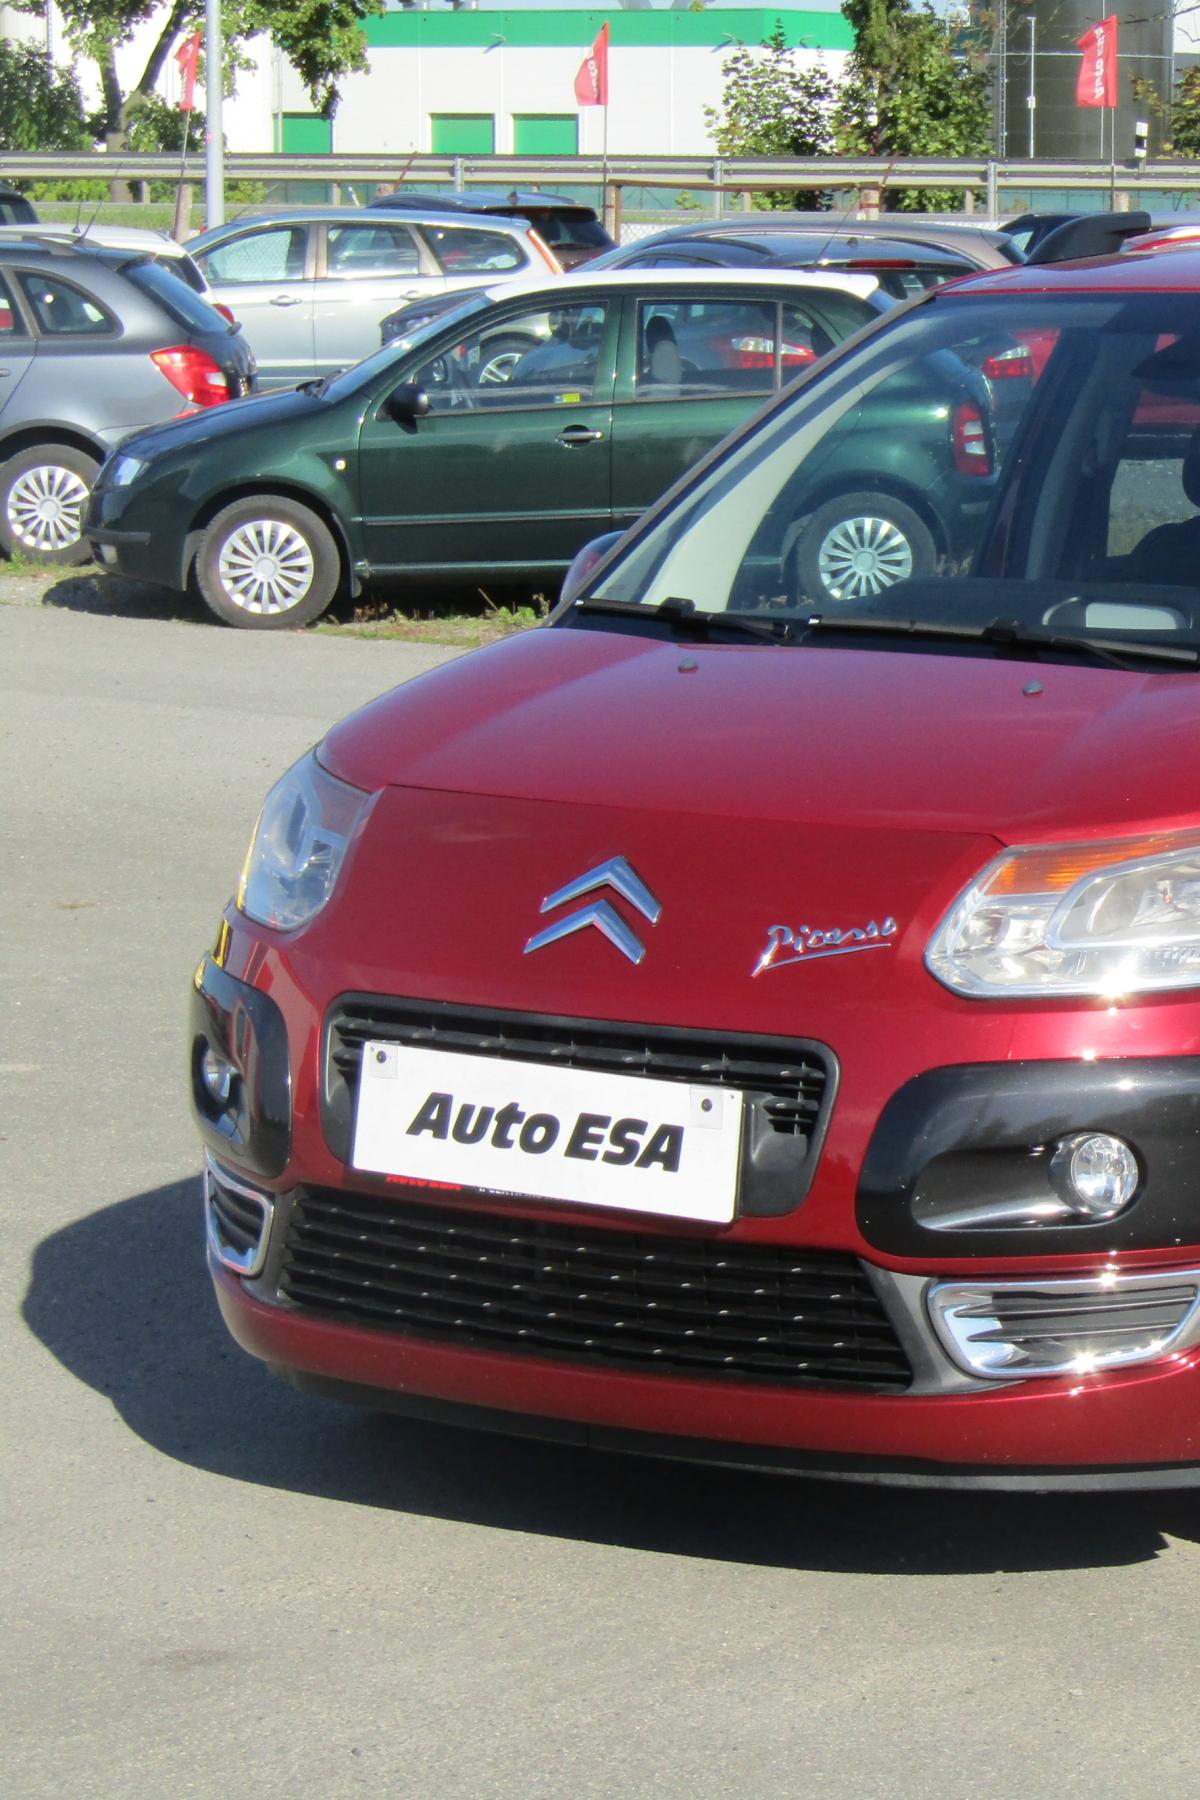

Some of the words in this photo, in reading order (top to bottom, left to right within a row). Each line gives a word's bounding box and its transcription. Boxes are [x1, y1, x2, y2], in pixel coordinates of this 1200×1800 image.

[751, 915, 898, 978] Picasso
[405, 1091, 561, 1155] Auto
[563, 1111, 685, 1173] ESA
